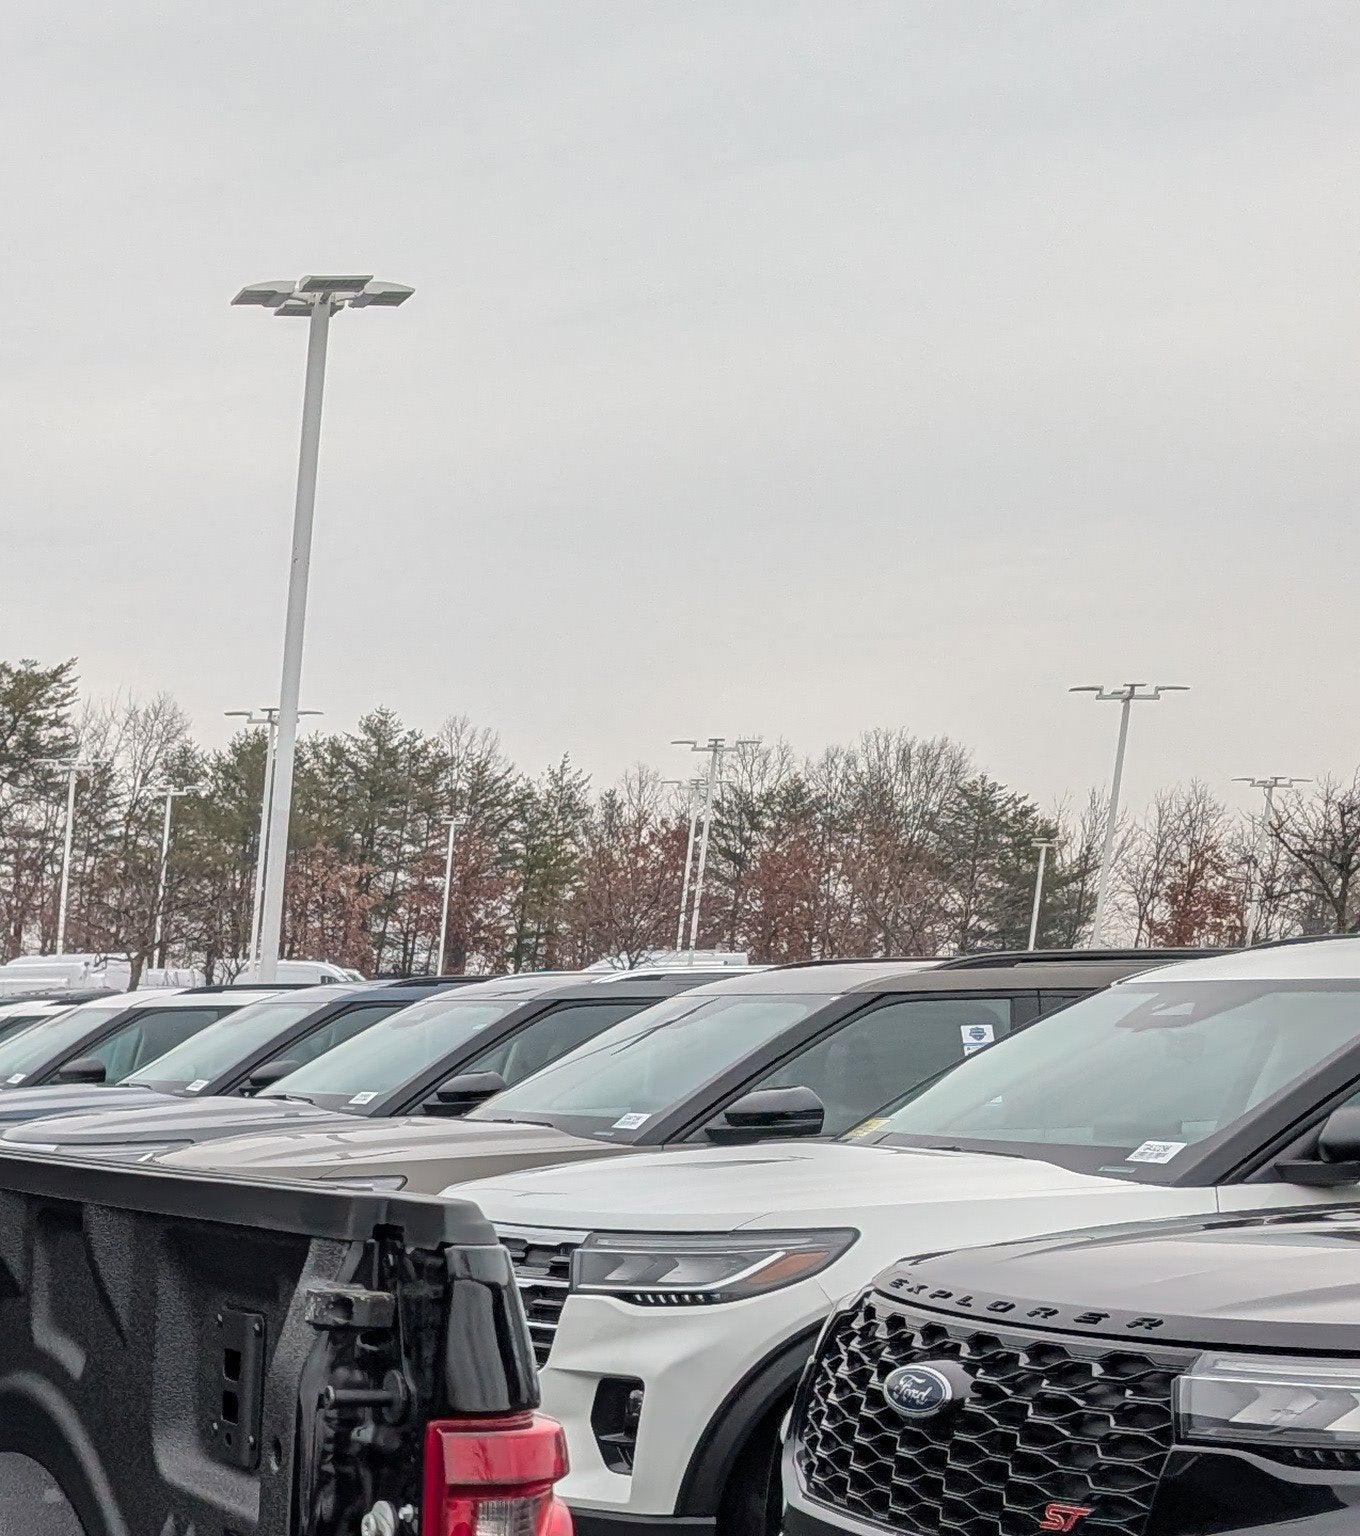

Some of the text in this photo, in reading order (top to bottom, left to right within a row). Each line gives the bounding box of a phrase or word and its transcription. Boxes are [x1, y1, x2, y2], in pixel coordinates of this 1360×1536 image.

[889, 1278, 1164, 1330] EXPLORER
[893, 1374, 934, 1406] Ford
[1039, 1503, 1093, 1532] ST
